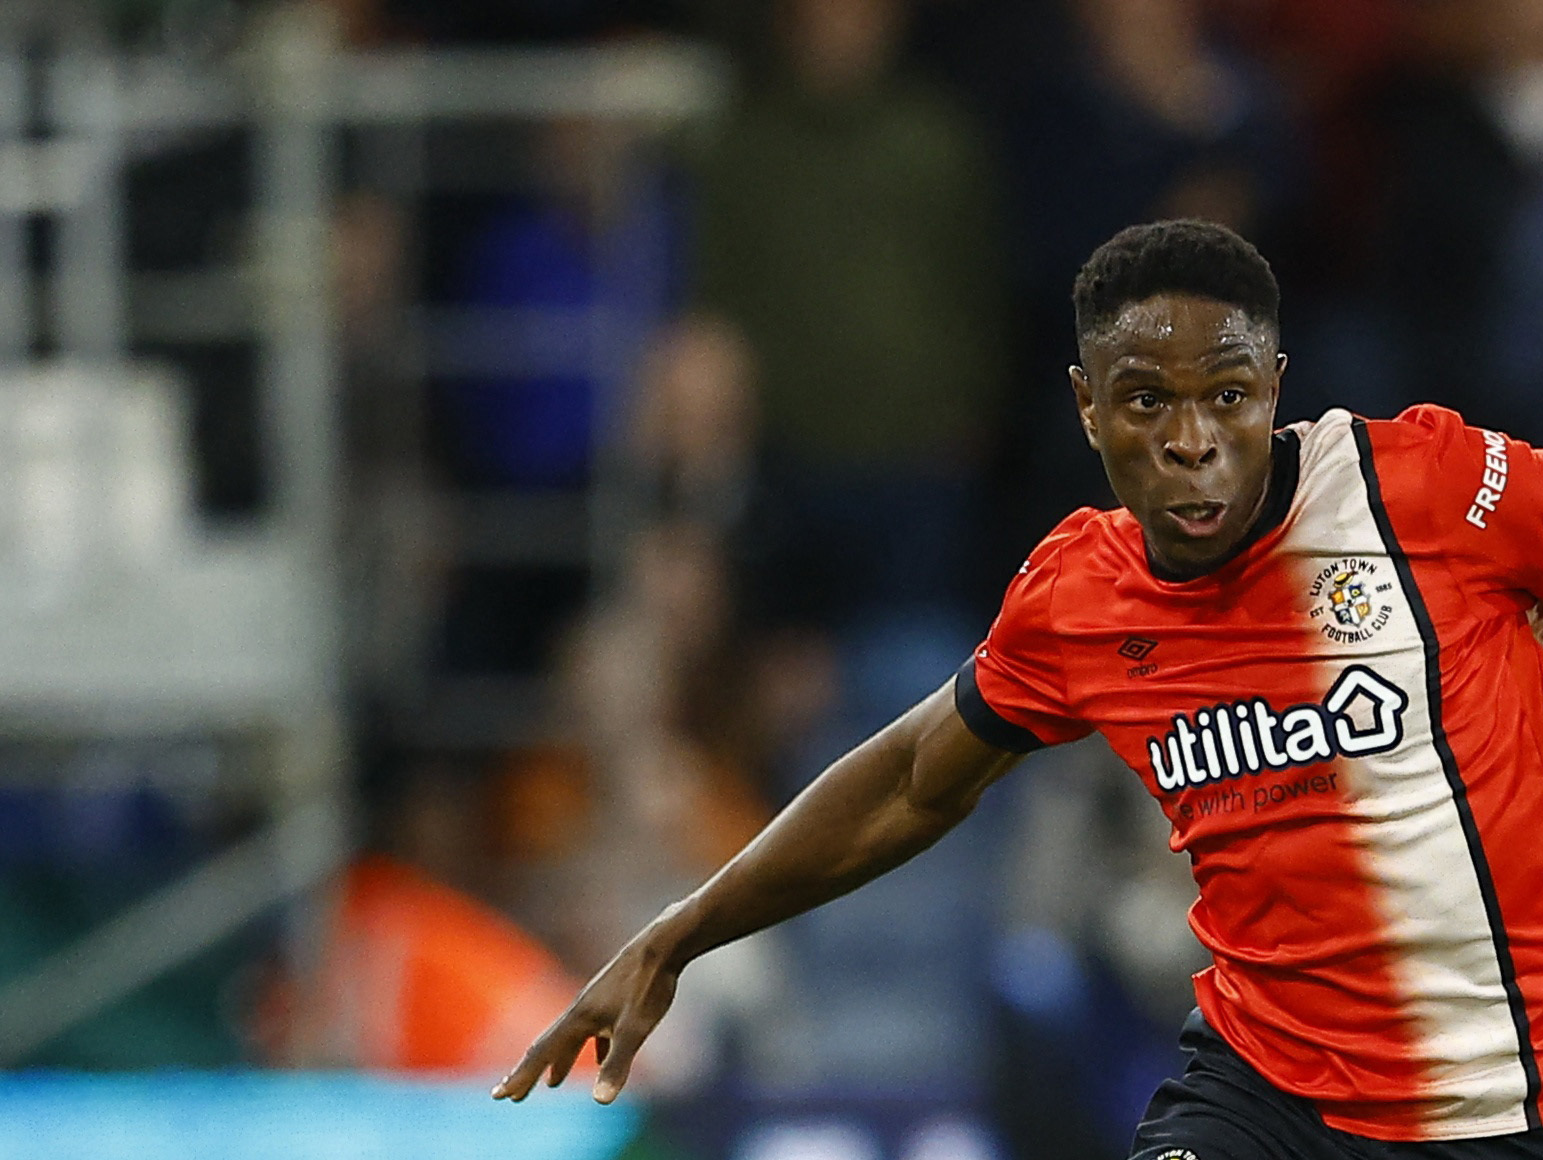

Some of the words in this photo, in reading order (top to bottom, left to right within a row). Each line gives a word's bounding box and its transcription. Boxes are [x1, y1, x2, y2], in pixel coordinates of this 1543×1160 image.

[1310, 562, 1339, 597] LUTON
[1342, 558, 1378, 575] TOWN
[1321, 623, 1373, 644] FOOTBALL
[1371, 605, 1392, 631] CLUB
[1149, 699, 1332, 790] utilita
[1198, 786, 1245, 817] with
[1254, 771, 1338, 814] power
